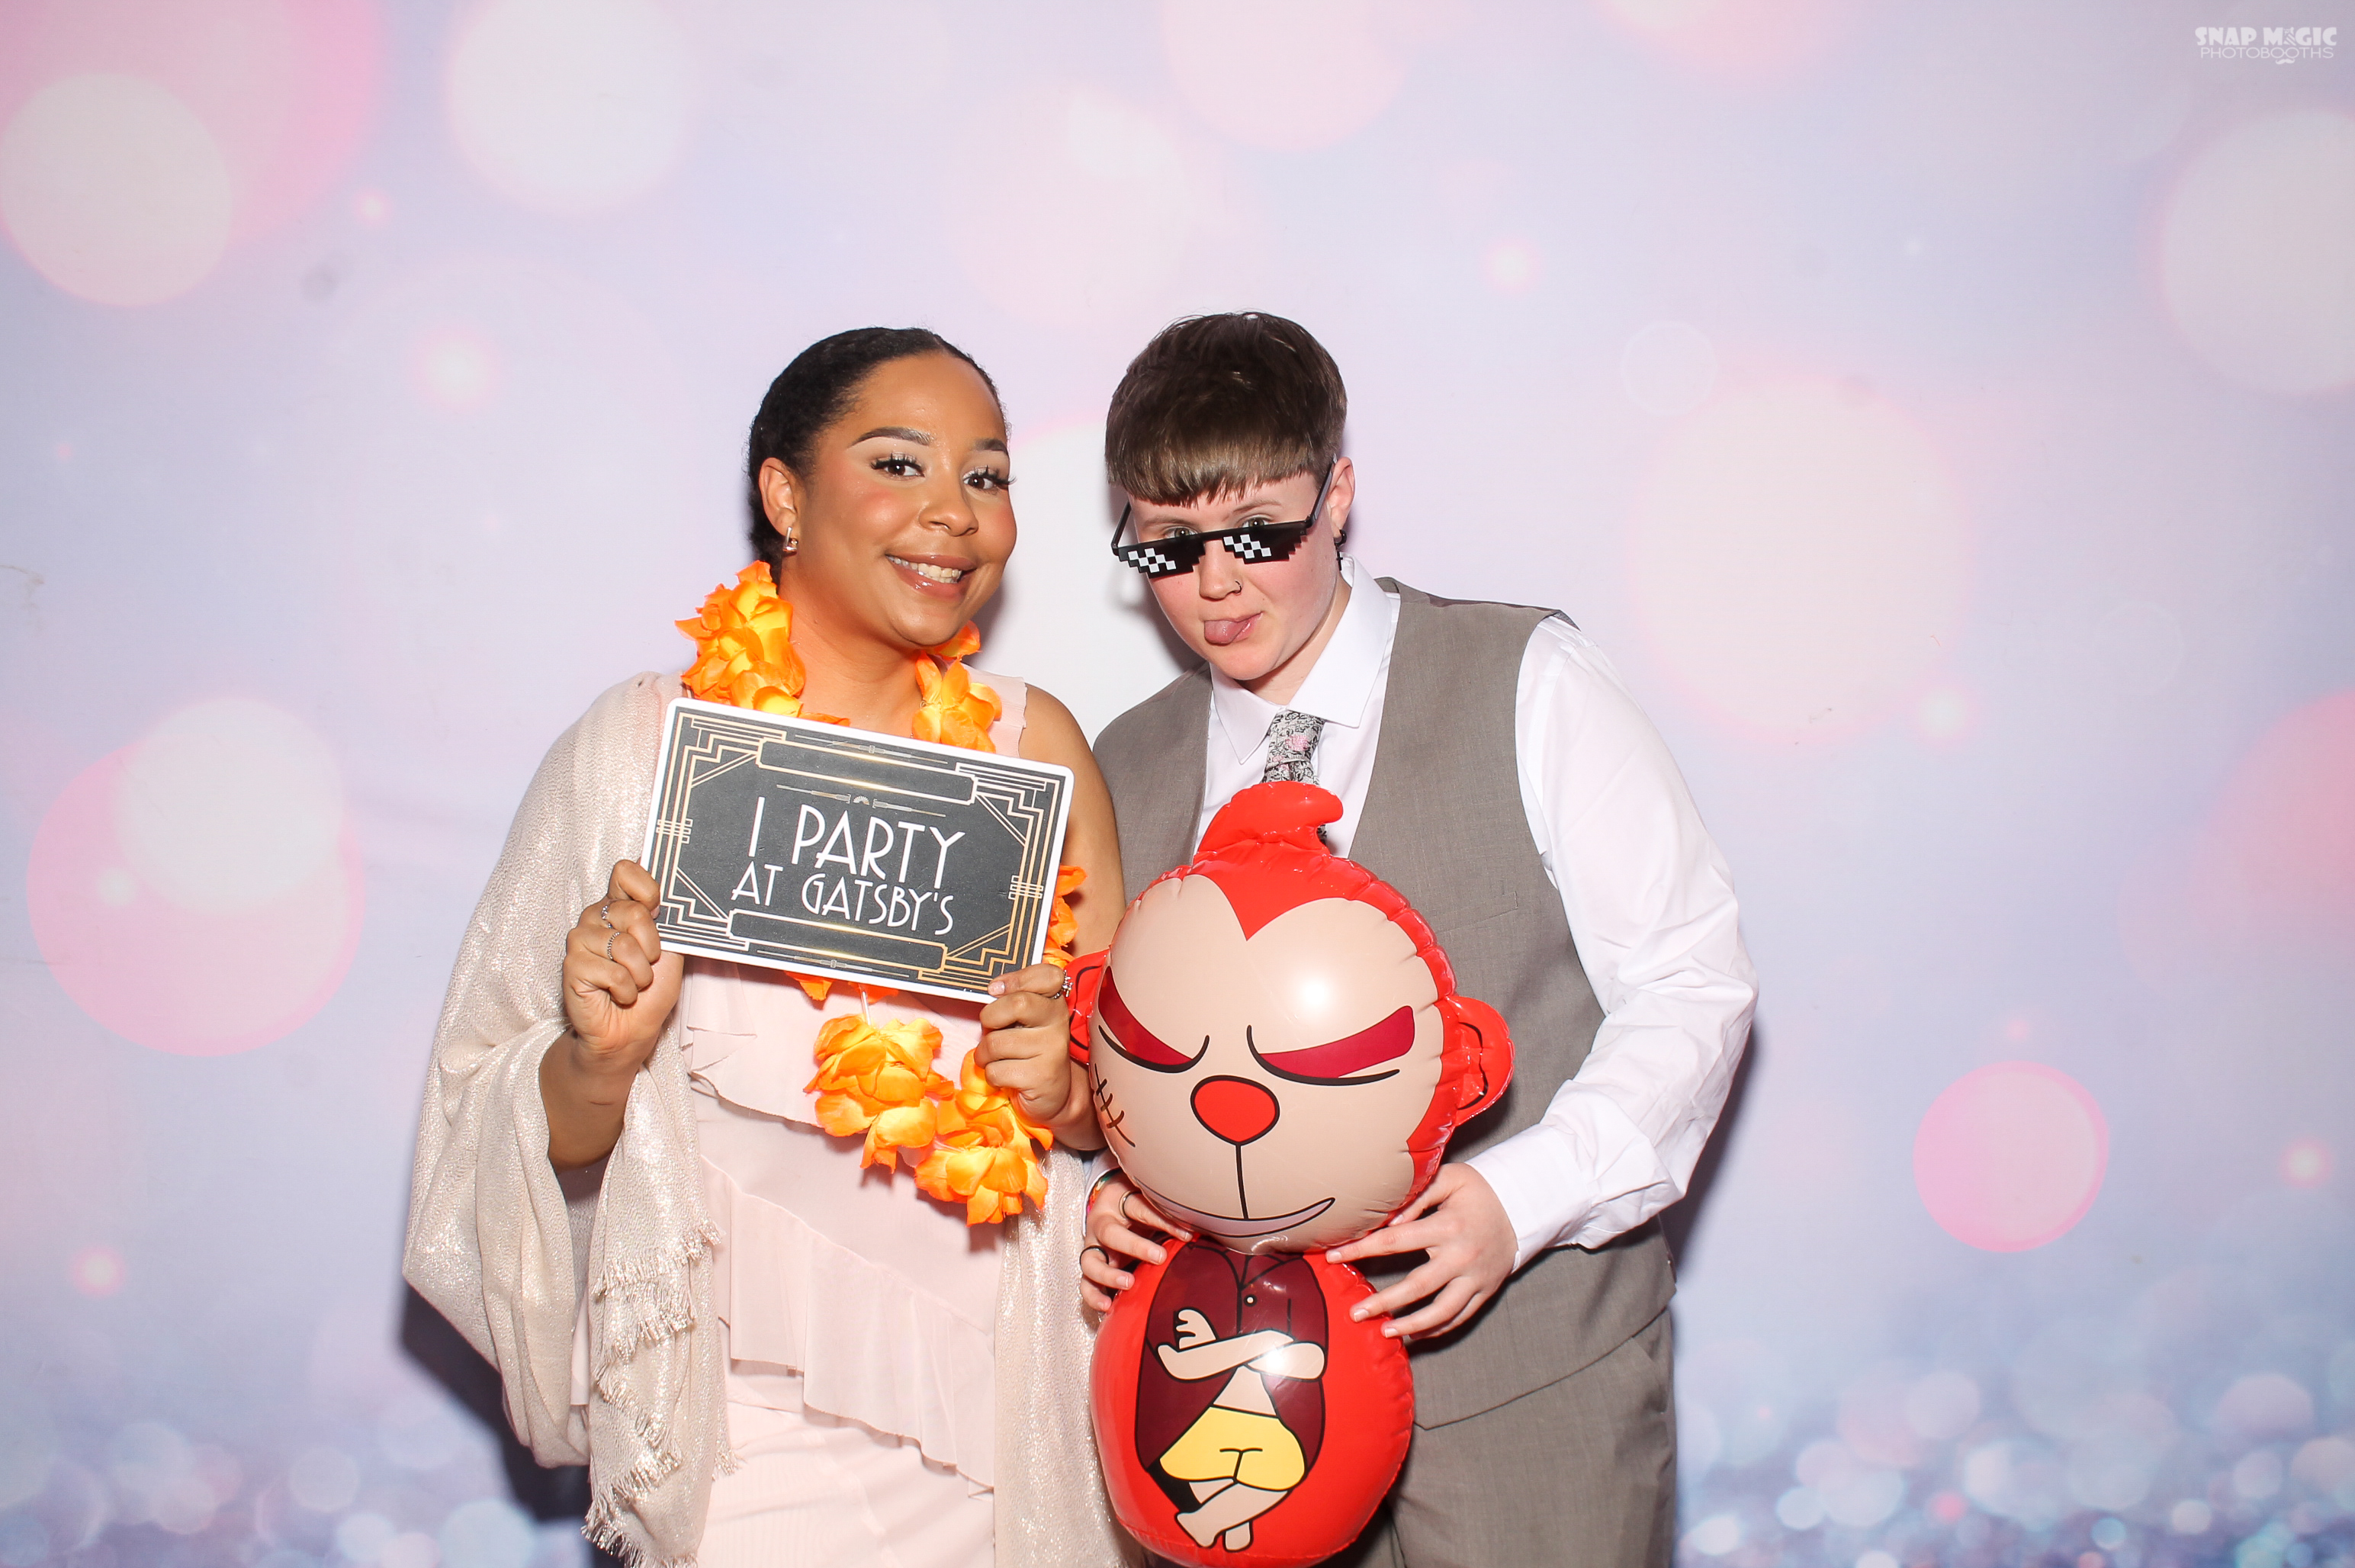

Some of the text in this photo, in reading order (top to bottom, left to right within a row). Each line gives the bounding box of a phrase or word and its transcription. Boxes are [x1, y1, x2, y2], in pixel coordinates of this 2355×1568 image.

[748, 796, 965, 888] I PARTY
[731, 861, 954, 934] AT GATSBY'S
